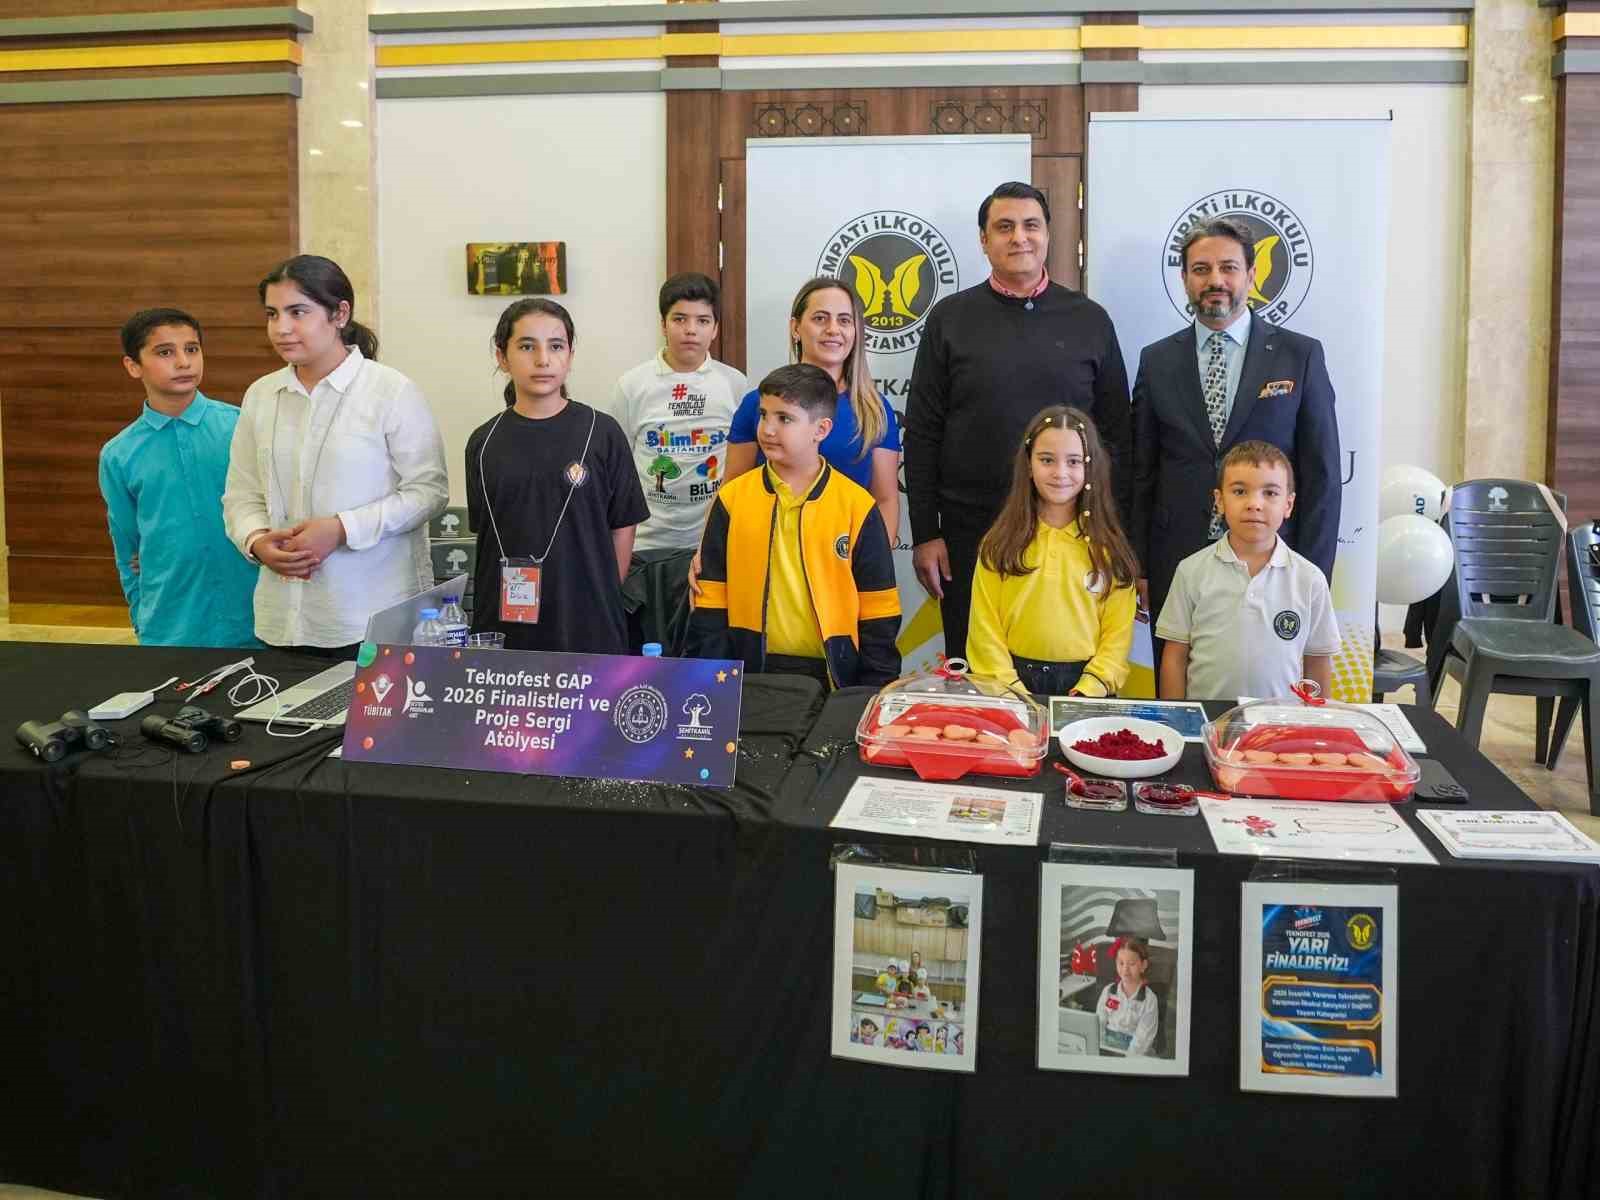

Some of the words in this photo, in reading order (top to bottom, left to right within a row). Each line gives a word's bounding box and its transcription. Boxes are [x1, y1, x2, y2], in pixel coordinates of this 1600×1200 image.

[871, 316, 904, 327] 2013
[465, 668, 551, 688] Teknofest
[556, 673, 593, 690] GAP
[443, 687, 486, 704] 2026
[490, 690, 584, 711] Finalistleri
[589, 698, 611, 712] ve
[475, 709, 520, 730] Proje
[525, 711, 572, 734] Sergi
[484, 730, 556, 752] Atölyesi
[1288, 937, 1329, 954] YARI
[1265, 951, 1350, 971] FİNALDEYİZ!
